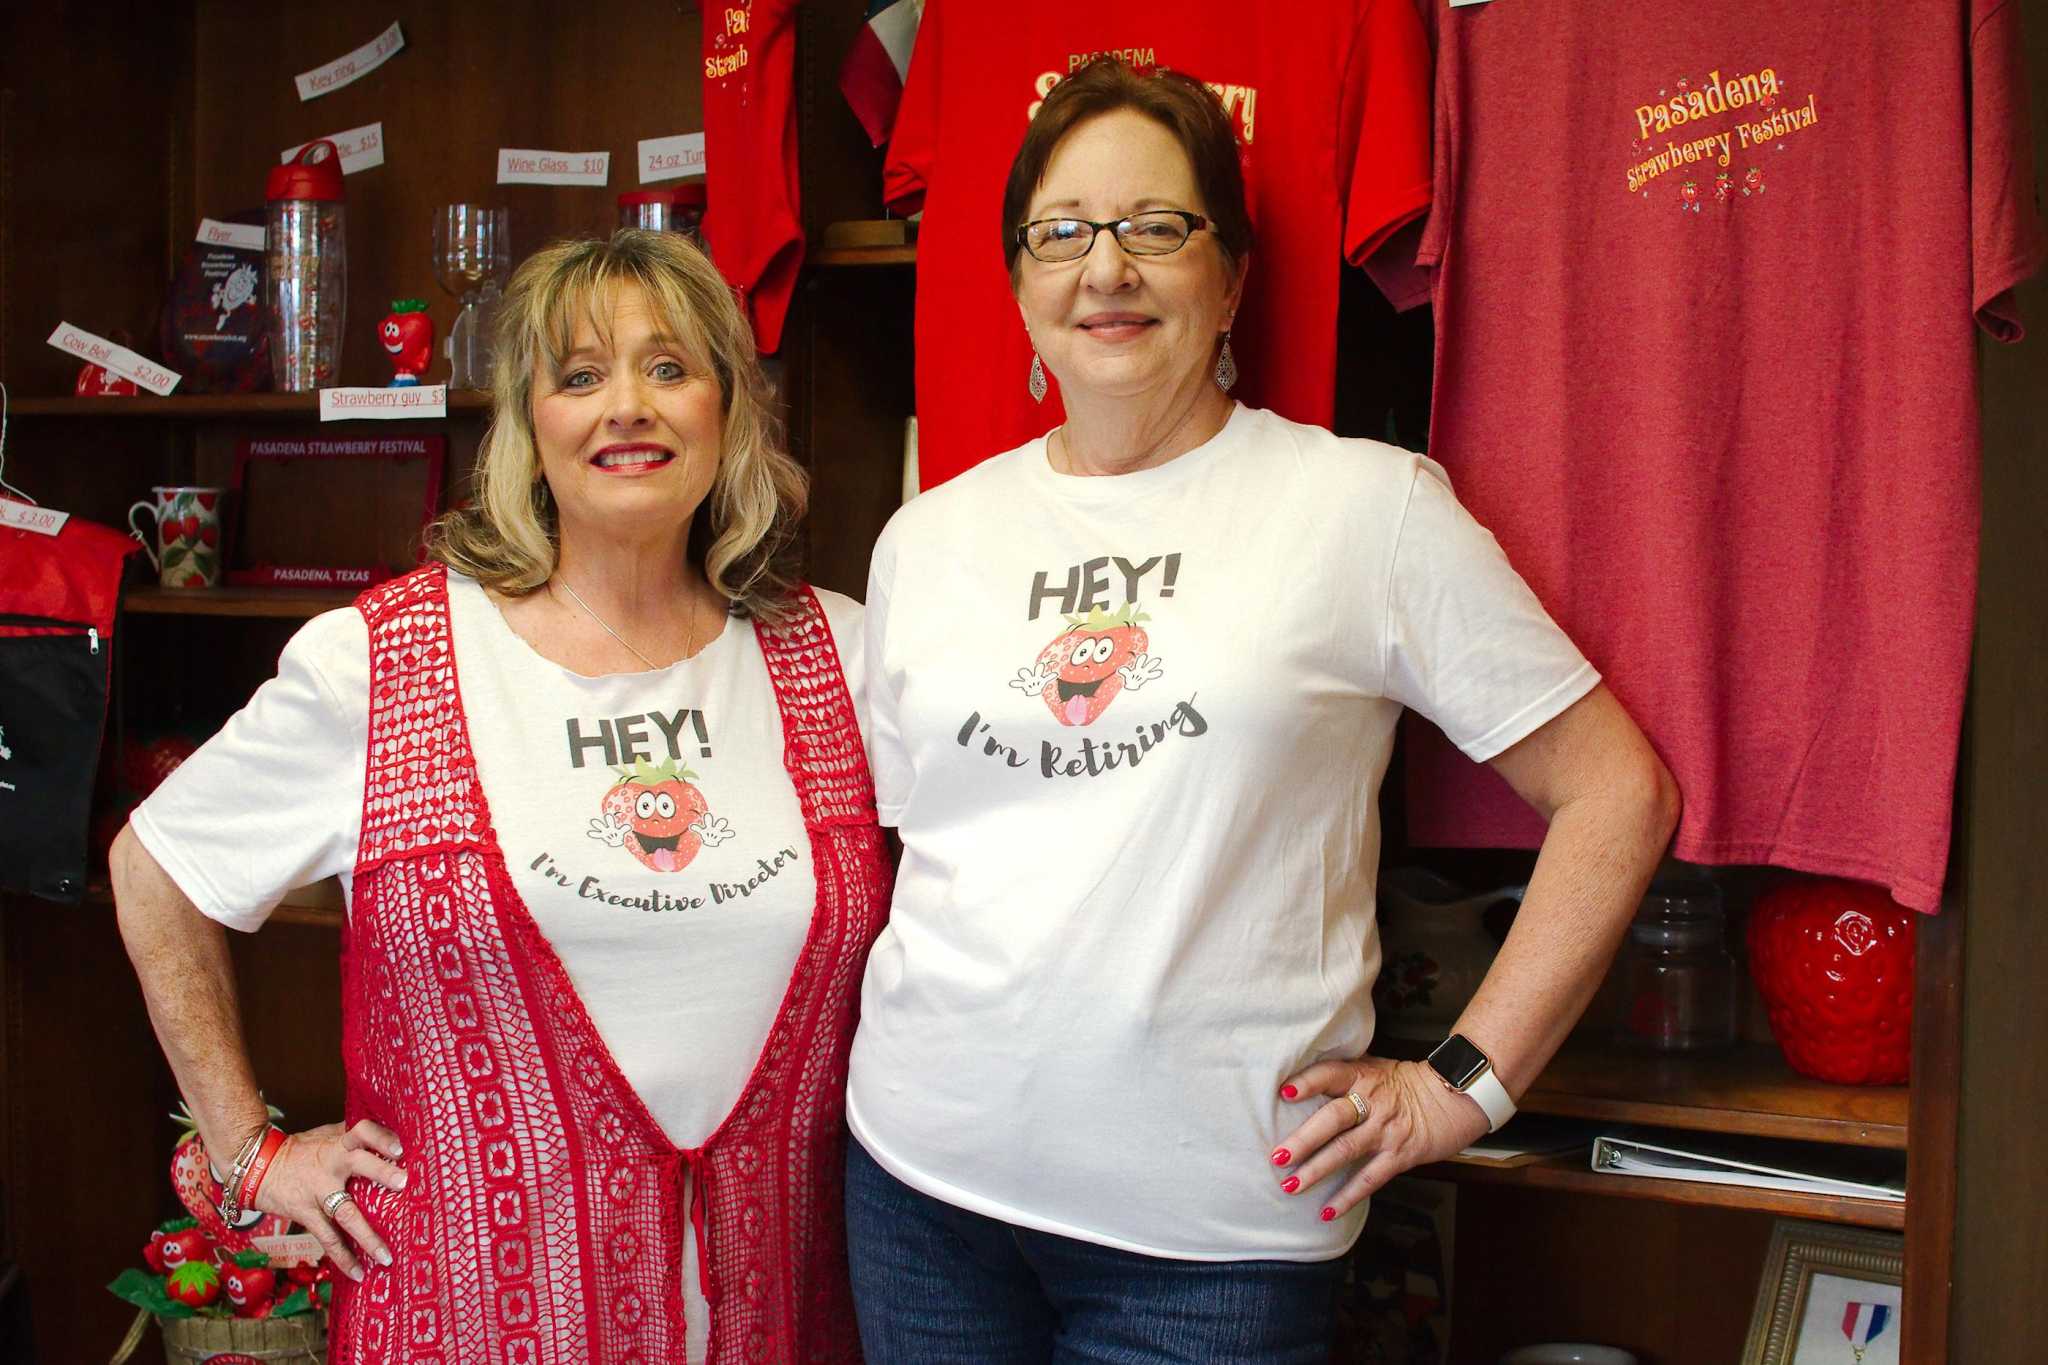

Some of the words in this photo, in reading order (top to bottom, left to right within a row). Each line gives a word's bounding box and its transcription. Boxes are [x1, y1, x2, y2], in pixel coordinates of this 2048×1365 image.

[1635, 68, 1780, 140] Pasadena
[1736, 94, 1818, 149] Festival
[507, 157, 535, 172] Wine
[538, 157, 568, 172] Glass
[583, 158, 604, 174] $10
[667, 155, 680, 168] oz
[208, 227, 233, 241] Flyer
[63, 333, 87, 351] Cow
[89, 344, 112, 360] Bell
[133, 364, 170, 387] $2.00
[332, 390, 397, 407] Strawberry
[401, 391, 422, 407] guy
[250, 442, 305, 454] PASADENA
[308, 441, 377, 455] STRAWBERRY
[379, 440, 426, 453] FESTIVAL
[273, 569, 333, 581] PASADENA,
[336, 570, 370, 581] TEXAS
[1028, 552, 1182, 621] HEY!
[566, 709, 712, 768] HEY!
[957, 711, 1029, 767] I'm
[1040, 691, 1208, 778] Retiring
[530, 852, 574, 887] I'm
[578, 875, 706, 912] Executive
[709, 845, 799, 905] Director
